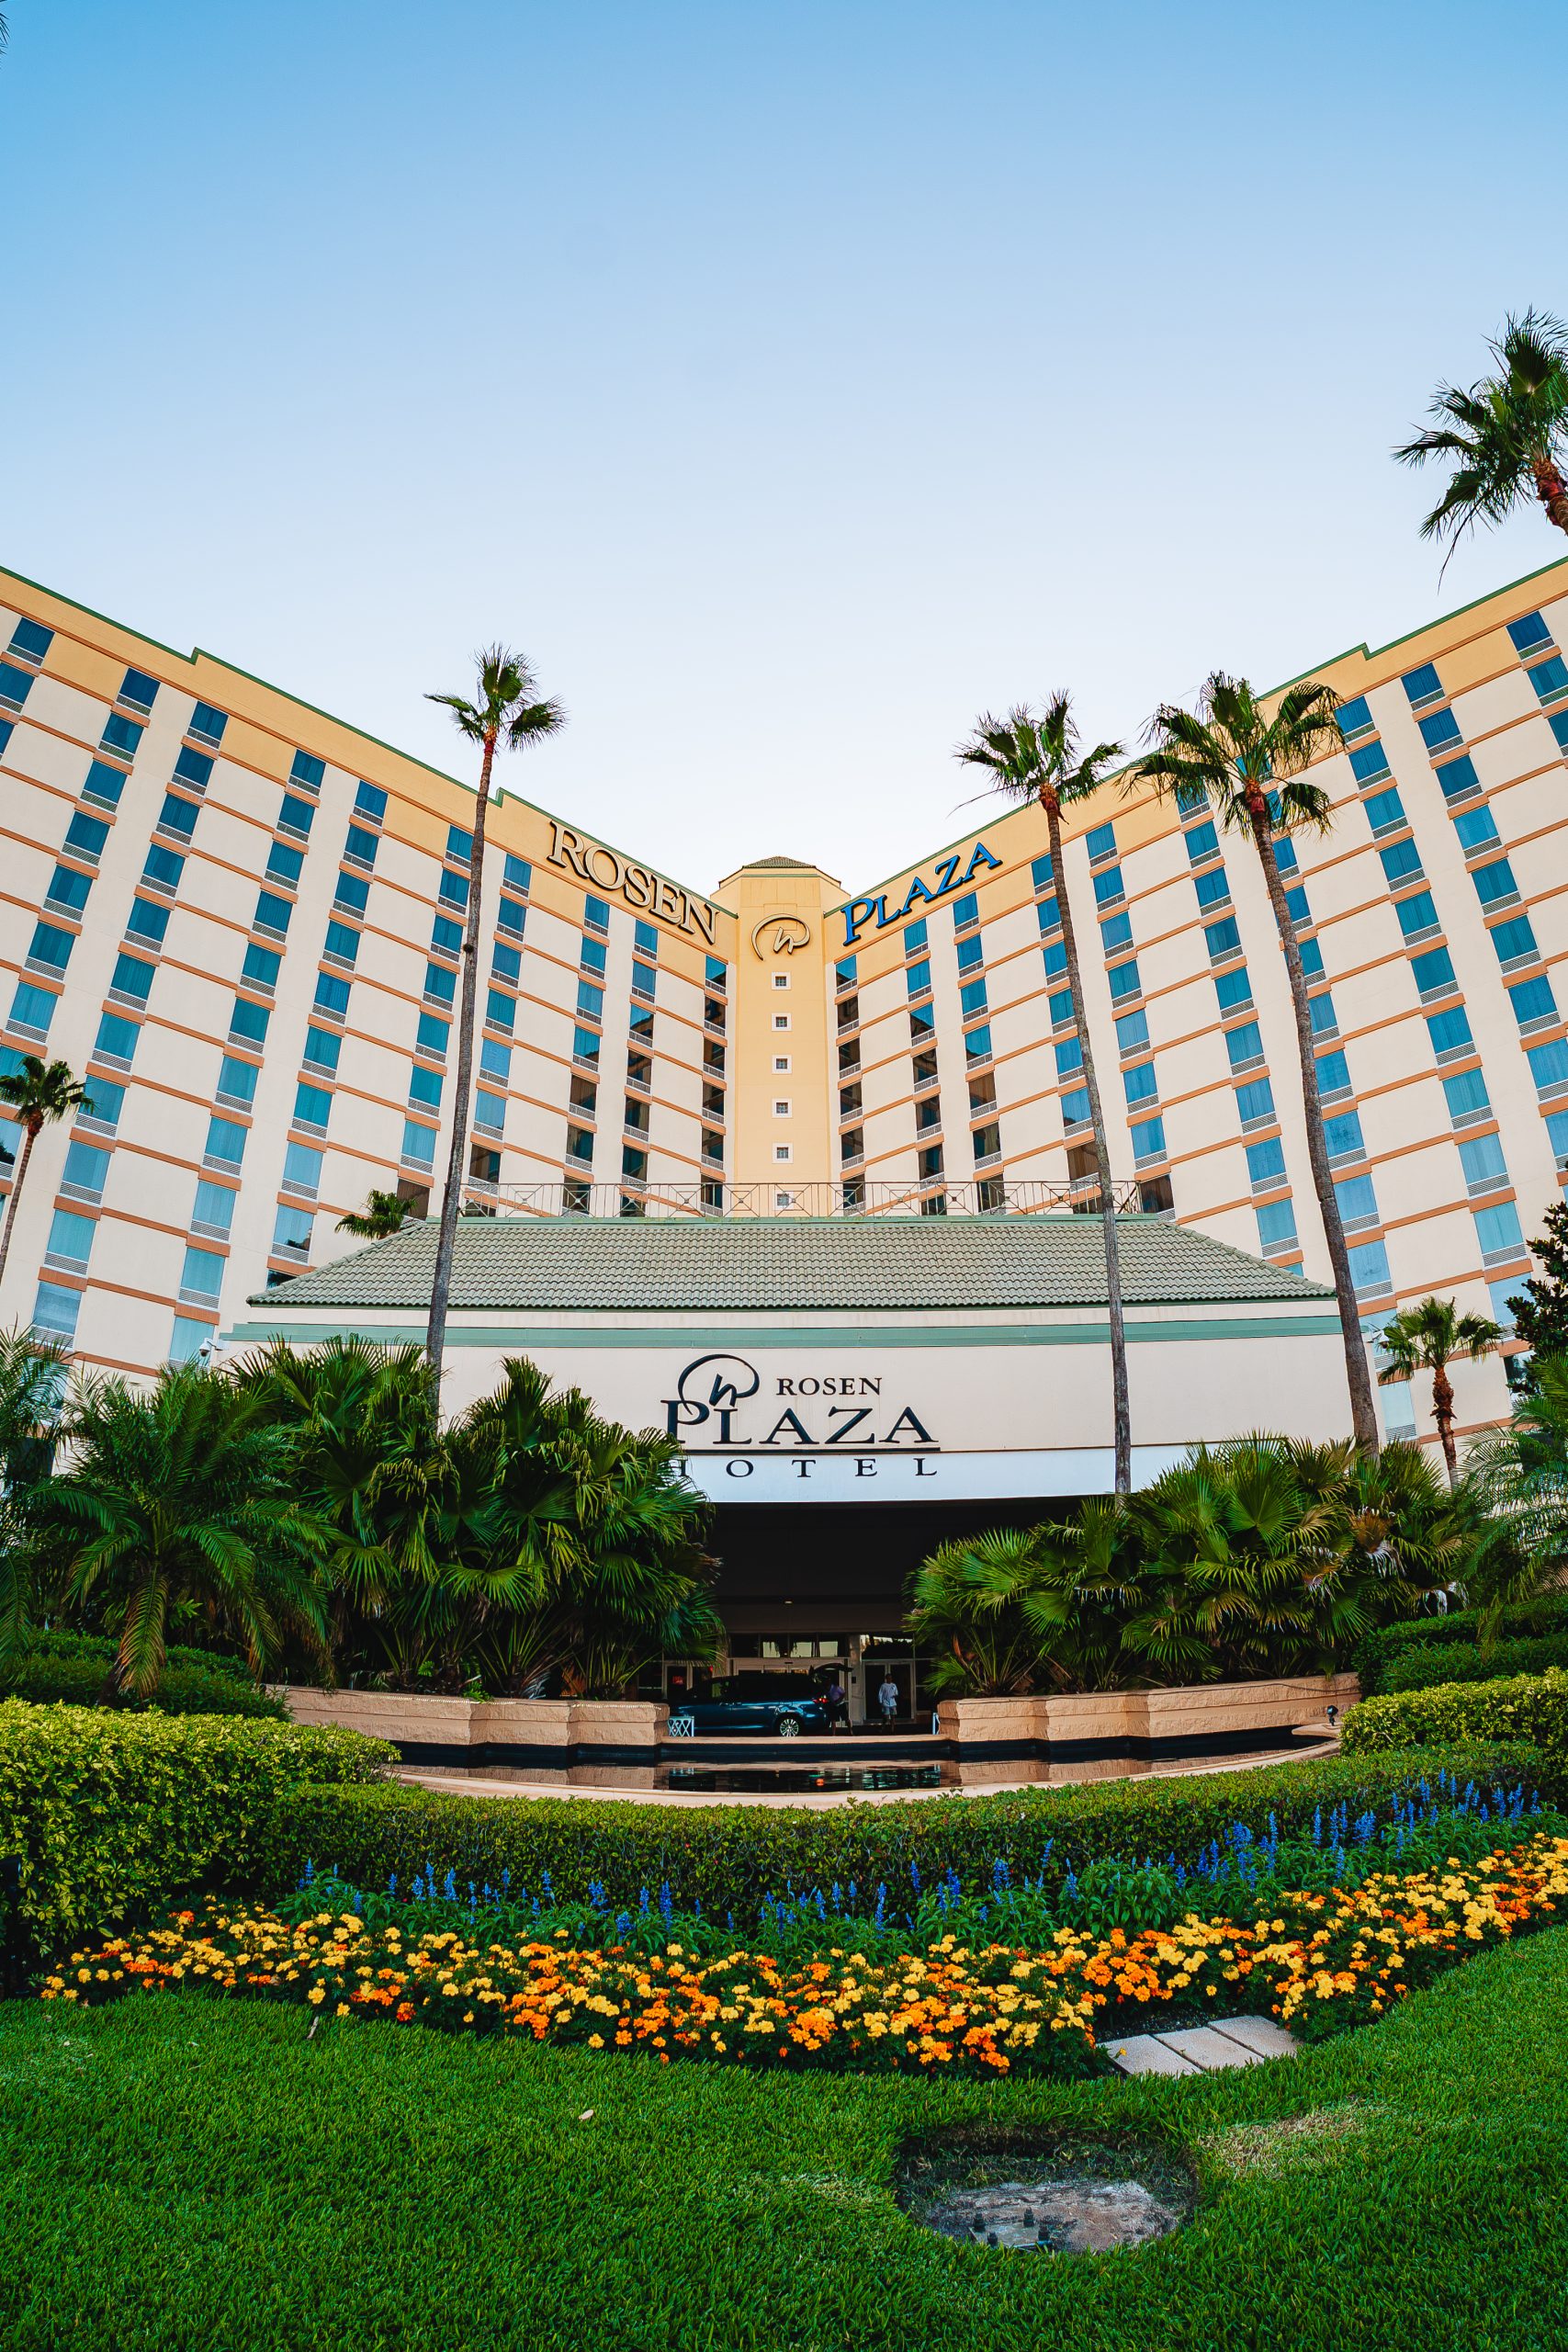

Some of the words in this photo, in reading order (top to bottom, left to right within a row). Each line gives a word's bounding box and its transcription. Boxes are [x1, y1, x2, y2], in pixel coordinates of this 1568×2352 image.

[548, 820, 718, 945] ROSEN
[840, 842, 1003, 946] PLAZA
[660, 1399, 939, 1444] PLAZA
[776, 1377, 882, 1396] ROSEN
